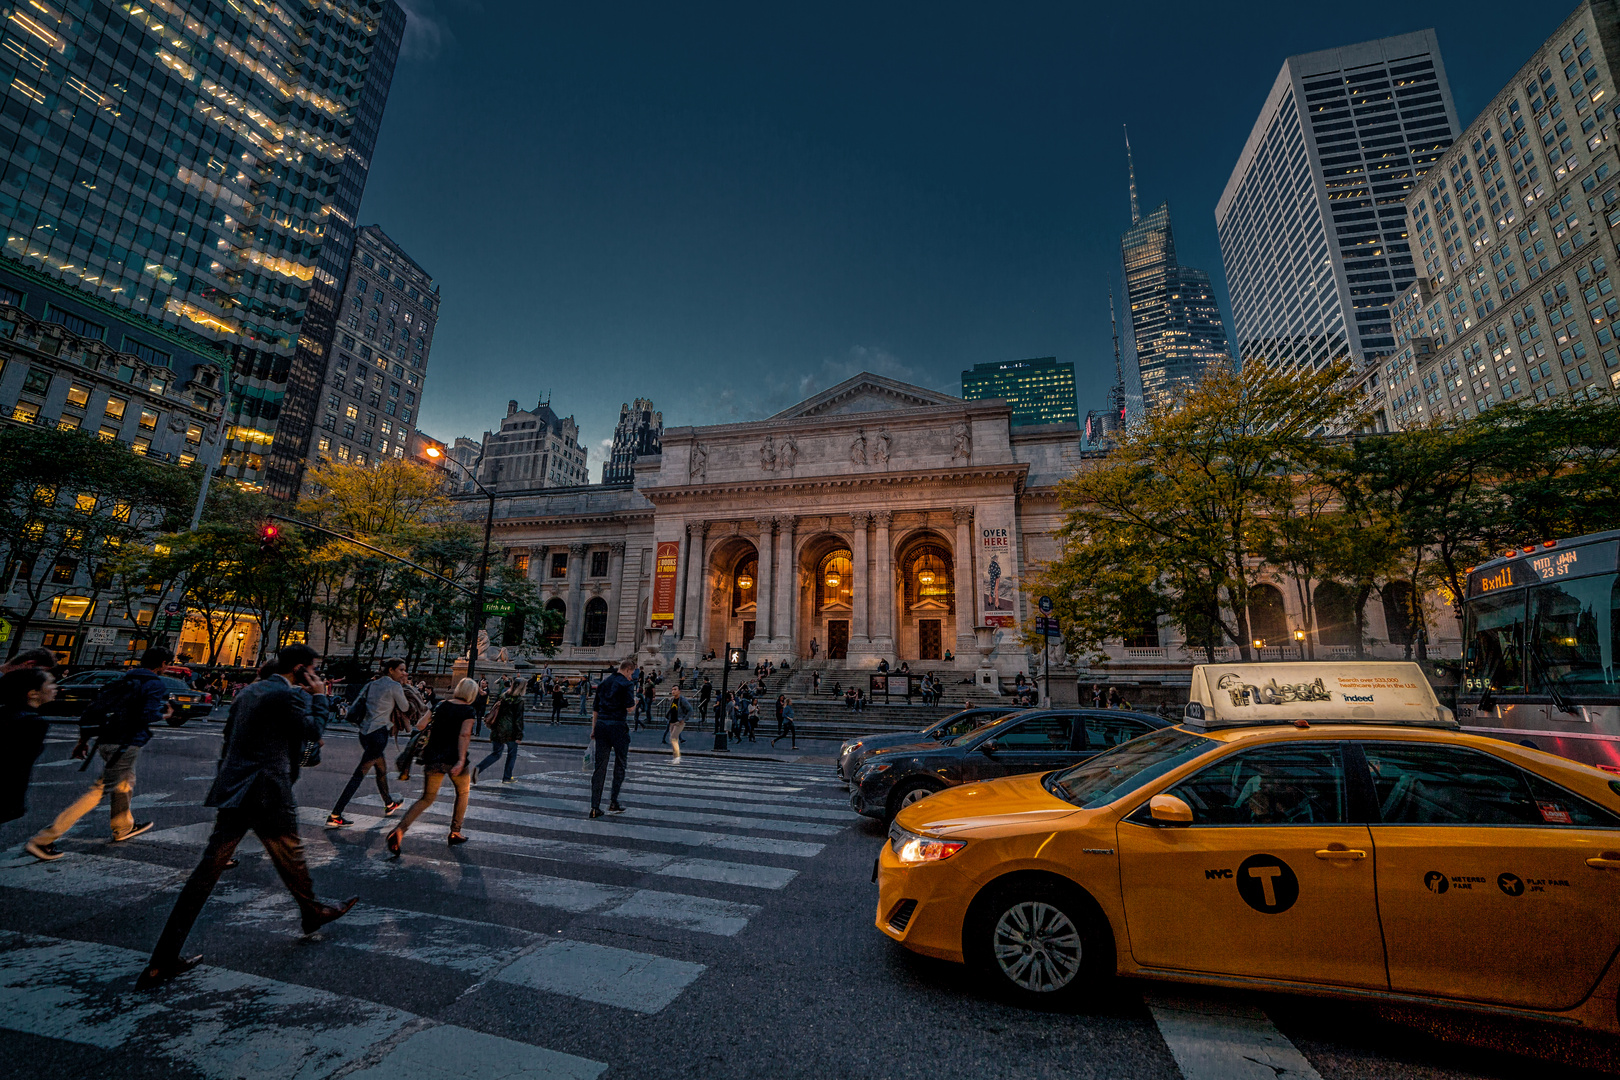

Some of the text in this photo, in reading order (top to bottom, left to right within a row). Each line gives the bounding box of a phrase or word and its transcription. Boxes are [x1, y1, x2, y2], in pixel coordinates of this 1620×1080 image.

[795, 496, 820, 504] YORK
[827, 494, 860, 503] PUBLIC
[869, 491, 909, 500] LIBRARY
[983, 529, 1007, 537] OVER
[984, 537, 1008, 546] HERE
[1542, 563, 1569, 579] 23 ST
[1342, 693, 1375, 702] indeed
[1204, 868, 1234, 880] NYC
[1247, 865, 1282, 906] T
[1526, 878, 1570, 887] FLAT FARE
